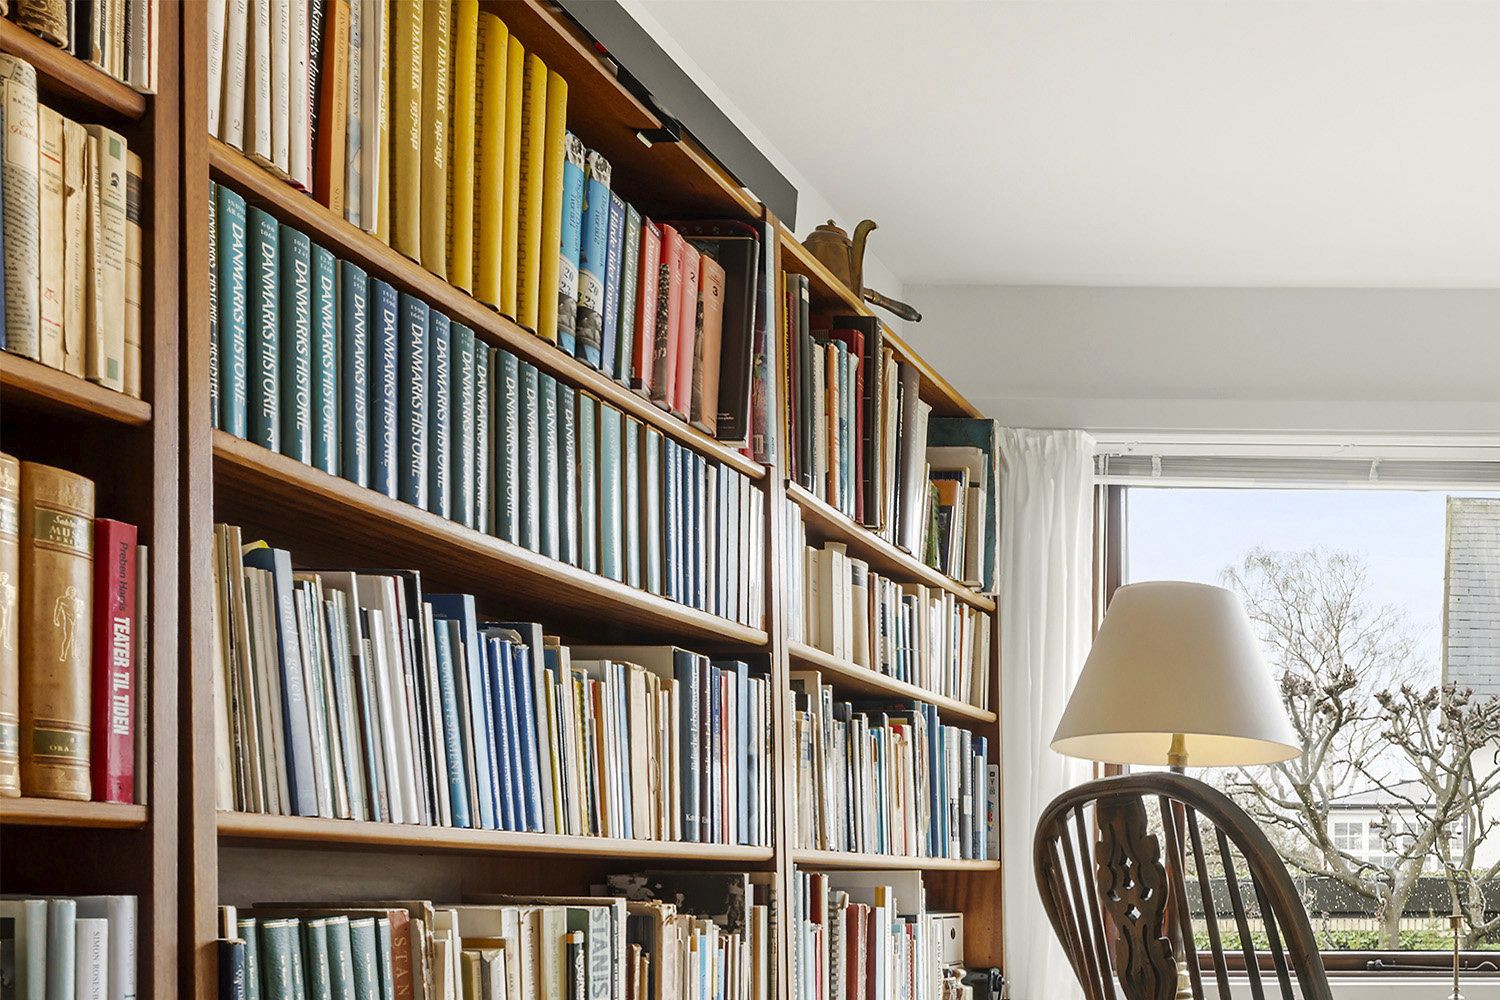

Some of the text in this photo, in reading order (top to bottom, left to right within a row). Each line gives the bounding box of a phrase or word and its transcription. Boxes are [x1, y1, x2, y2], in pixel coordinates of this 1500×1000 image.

[309, 0, 323, 58] okratiets
[412, 22, 420, 91] DANMARK
[436, 43, 446, 114] DANMARK
[607, 250, 617, 276] tider
[609, 208, 619, 248] Hårde
[645, 238, 655, 296] Danmark
[232, 222, 245, 405] DANMARKS HISTORIE
[261, 242, 276, 419] DANMARKS HISTORIE
[295, 259, 310, 430] DANMARKS HISTORIE
[606, 277, 616, 325] forude
[711, 285, 719, 296] 3
[321, 275, 334, 442] DANMARKS HISTORIE
[354, 294, 366, 456] DANMARKS HISTORIE
[383, 309, 395, 467] DANMARKS HISTORIE
[411, 323, 424, 478] DANMARKS HISTORIE
[437, 337, 448, 488] DANMARKS HISTORIE
[462, 350, 473, 432] DANMARKS
[477, 364, 487, 444] DANMARKS
[505, 376, 516, 518] DANMARKS HISTORIE
[526, 388, 537, 526] DANMARKS HISTORIE
[112, 542, 130, 736] Preben Harris TEATER TIL TIDEN
[286, 657, 302, 702] geven
[439, 635, 461, 784] DET GAMLE TESTAMENTE
[92, 931, 100, 961] SIMON
